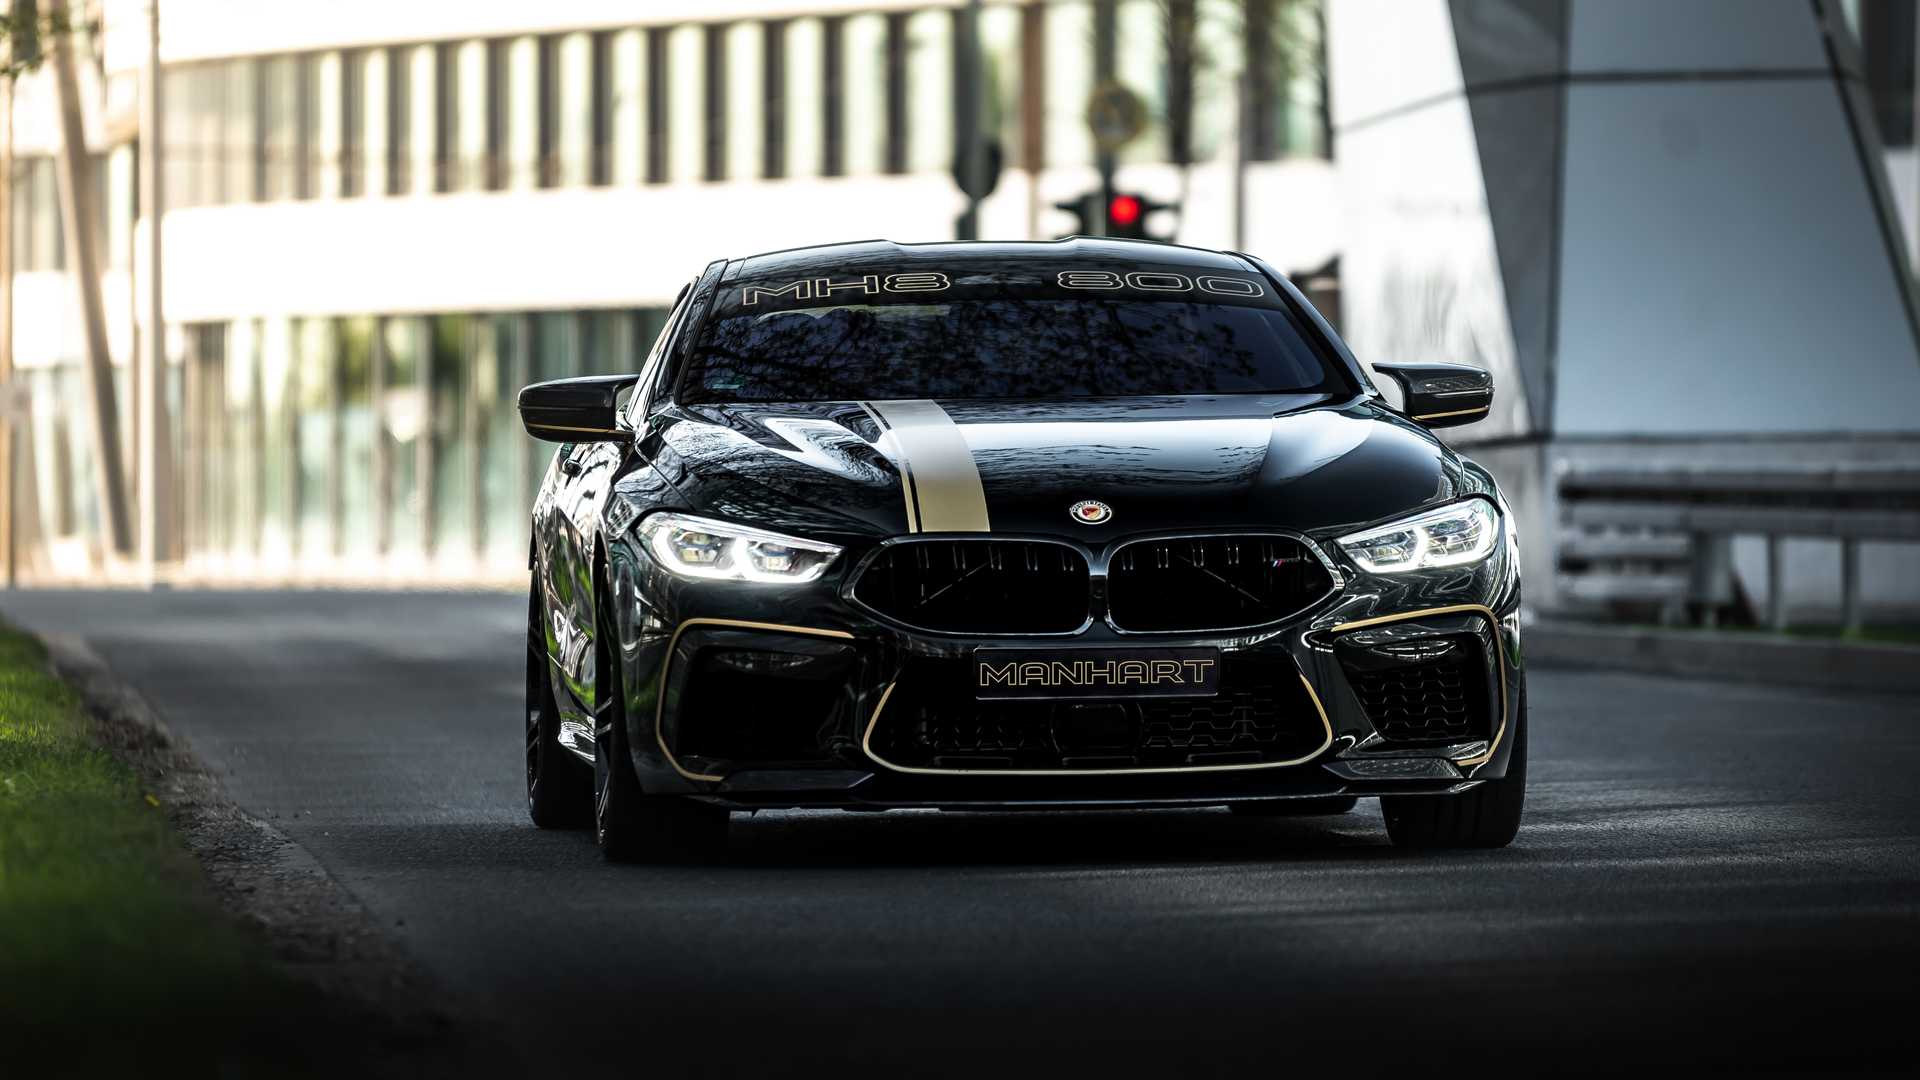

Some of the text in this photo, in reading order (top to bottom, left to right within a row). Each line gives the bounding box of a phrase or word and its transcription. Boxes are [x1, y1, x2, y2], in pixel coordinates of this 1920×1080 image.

[743, 270, 1264, 306] MH8 800
[980, 659, 1214, 686] MANHART
